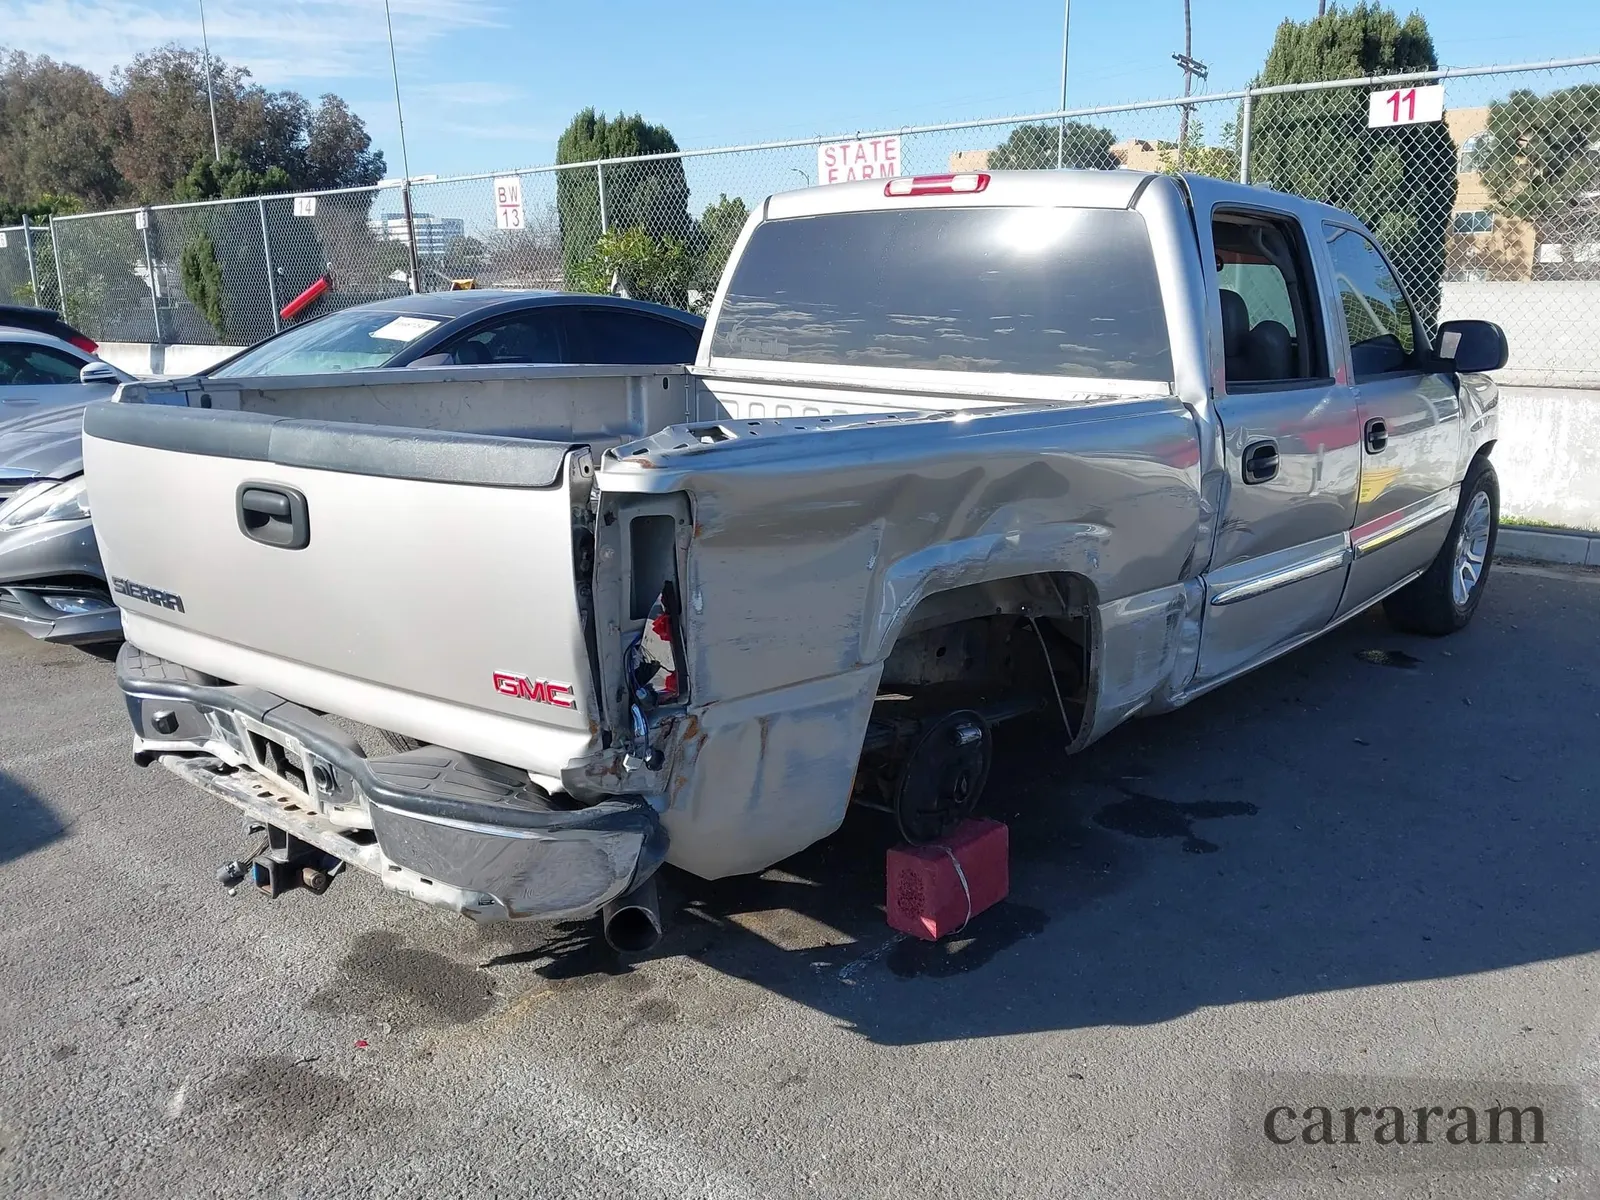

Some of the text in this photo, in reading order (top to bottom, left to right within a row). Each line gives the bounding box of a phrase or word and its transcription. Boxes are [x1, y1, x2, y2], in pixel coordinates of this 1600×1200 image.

[1387, 89, 1416, 122] 11
[825, 139, 896, 167] STATE
[298, 199, 312, 215] 14
[498, 186, 518, 203] BW
[502, 208, 520, 228] 13
[111, 575, 186, 614] SIERRA
[493, 669, 578, 711] GMC
